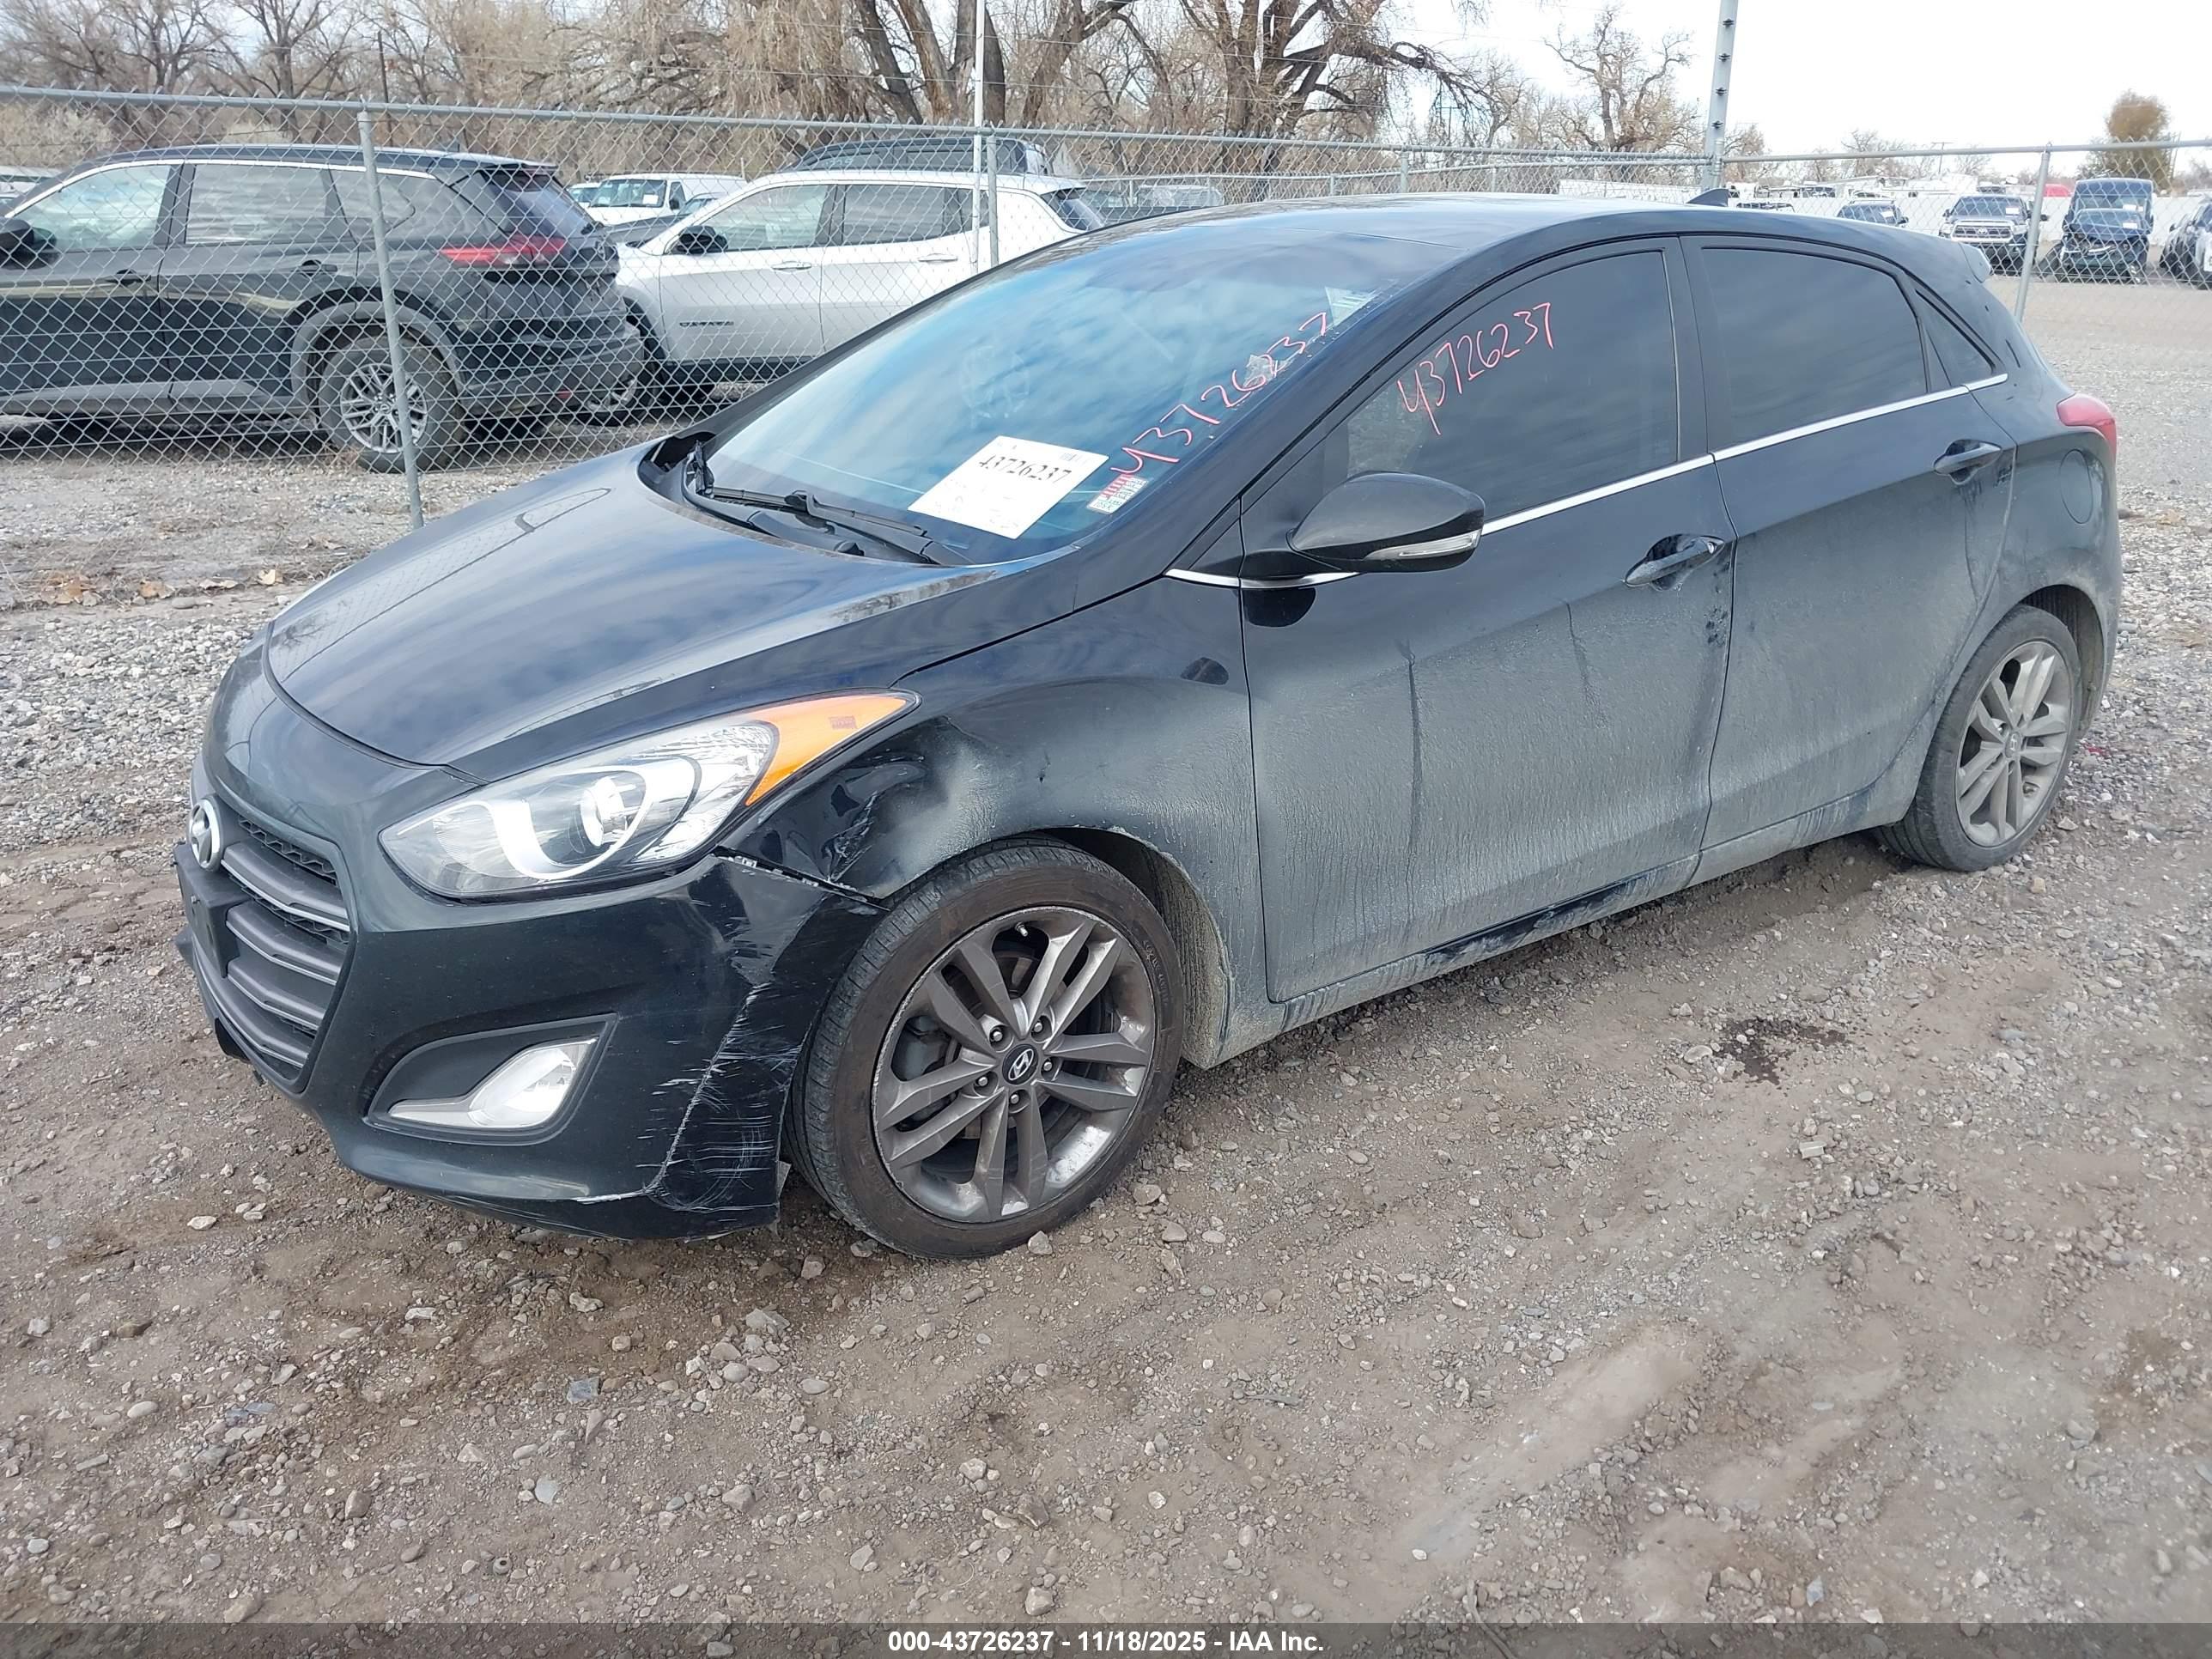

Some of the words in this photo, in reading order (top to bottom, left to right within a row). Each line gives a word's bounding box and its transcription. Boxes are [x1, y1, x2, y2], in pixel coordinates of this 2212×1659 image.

[1110, 312, 1328, 476] 43726237
[1396, 302, 1554, 436] 43726237
[978, 453, 1073, 485] 43726237
